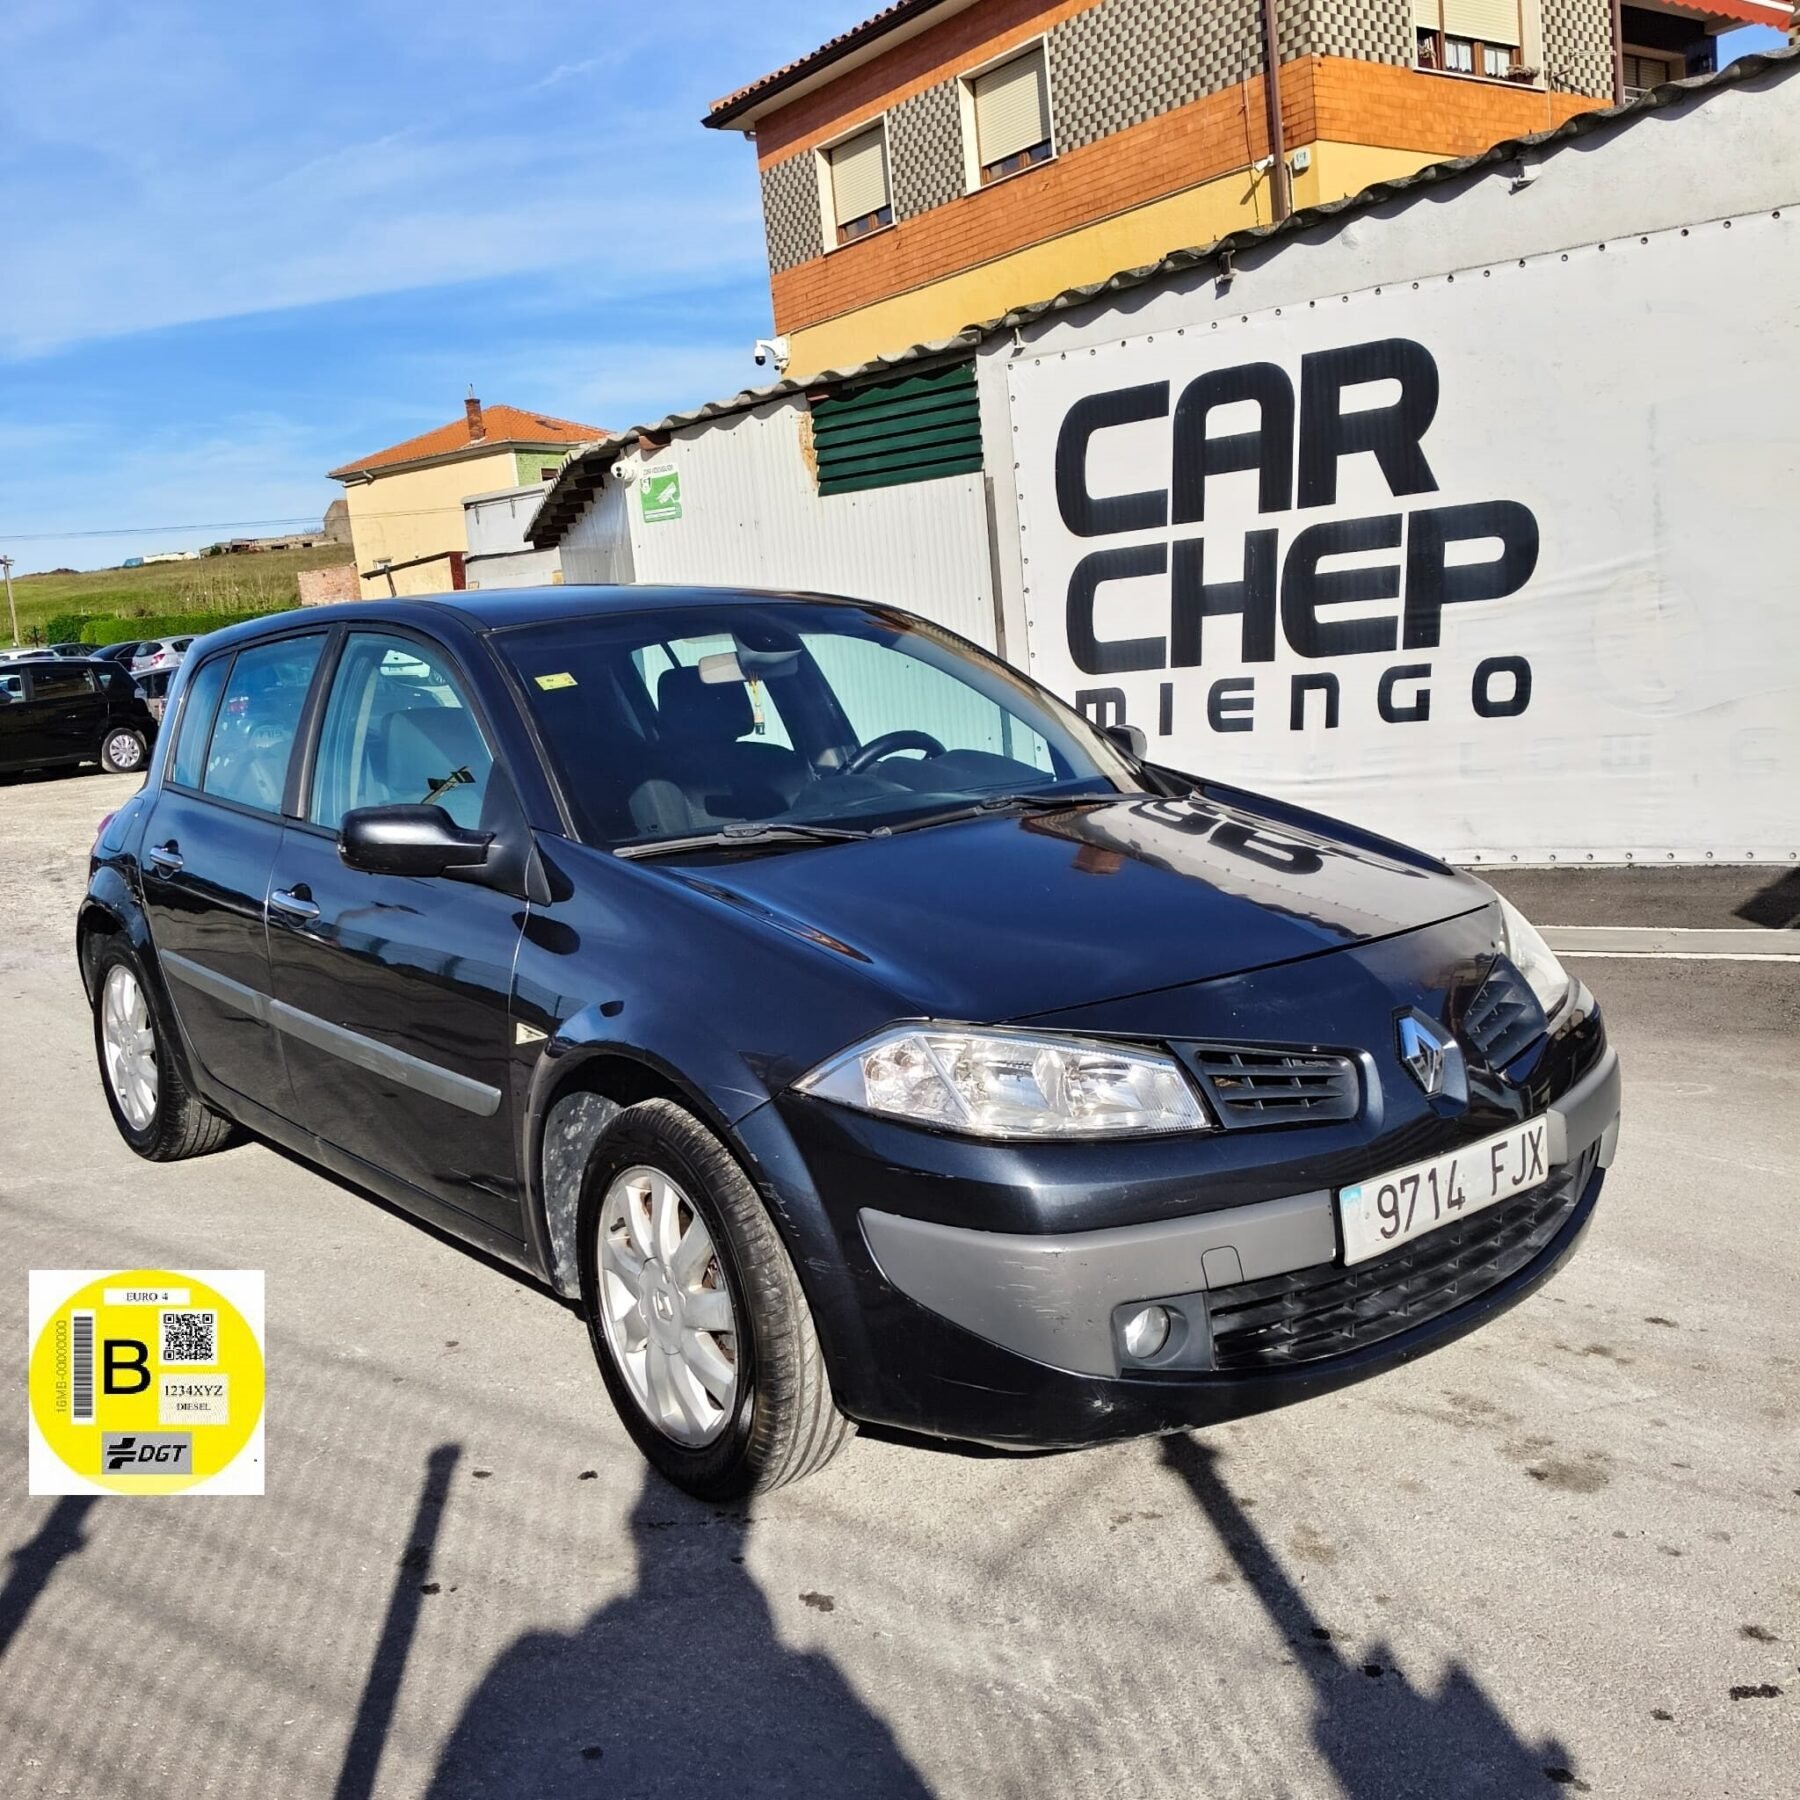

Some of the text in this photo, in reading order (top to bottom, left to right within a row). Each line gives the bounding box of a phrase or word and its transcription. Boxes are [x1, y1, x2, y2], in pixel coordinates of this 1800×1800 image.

[1055, 337, 1440, 538] CAR
[1065, 499, 1540, 675] CHEP
[1376, 1125, 1544, 1240] 9714 FJX
